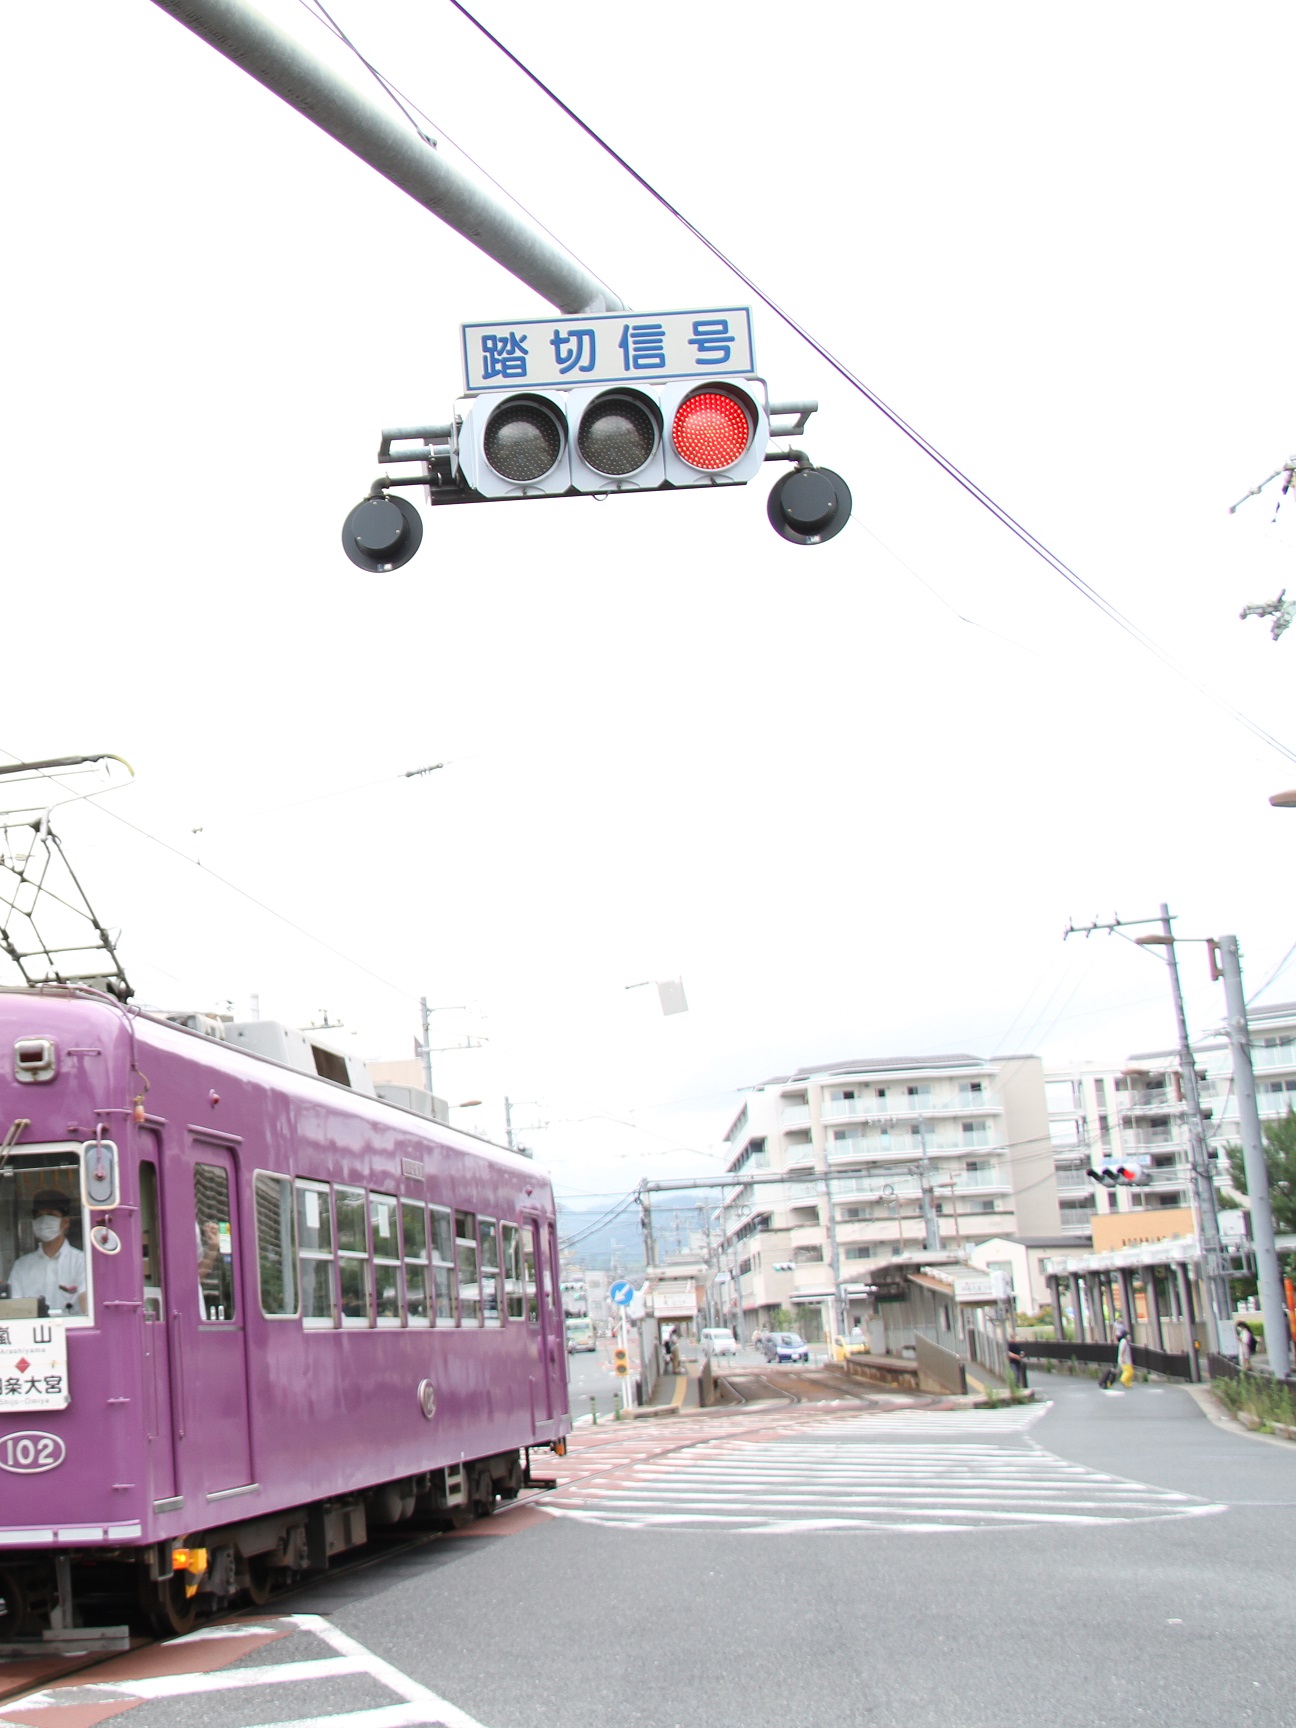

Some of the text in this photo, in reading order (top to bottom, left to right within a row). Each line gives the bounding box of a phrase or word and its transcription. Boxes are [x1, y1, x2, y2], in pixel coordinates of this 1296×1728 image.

[480, 318, 736, 380] 踏切信号
[6, 1438, 55, 1465] 102
